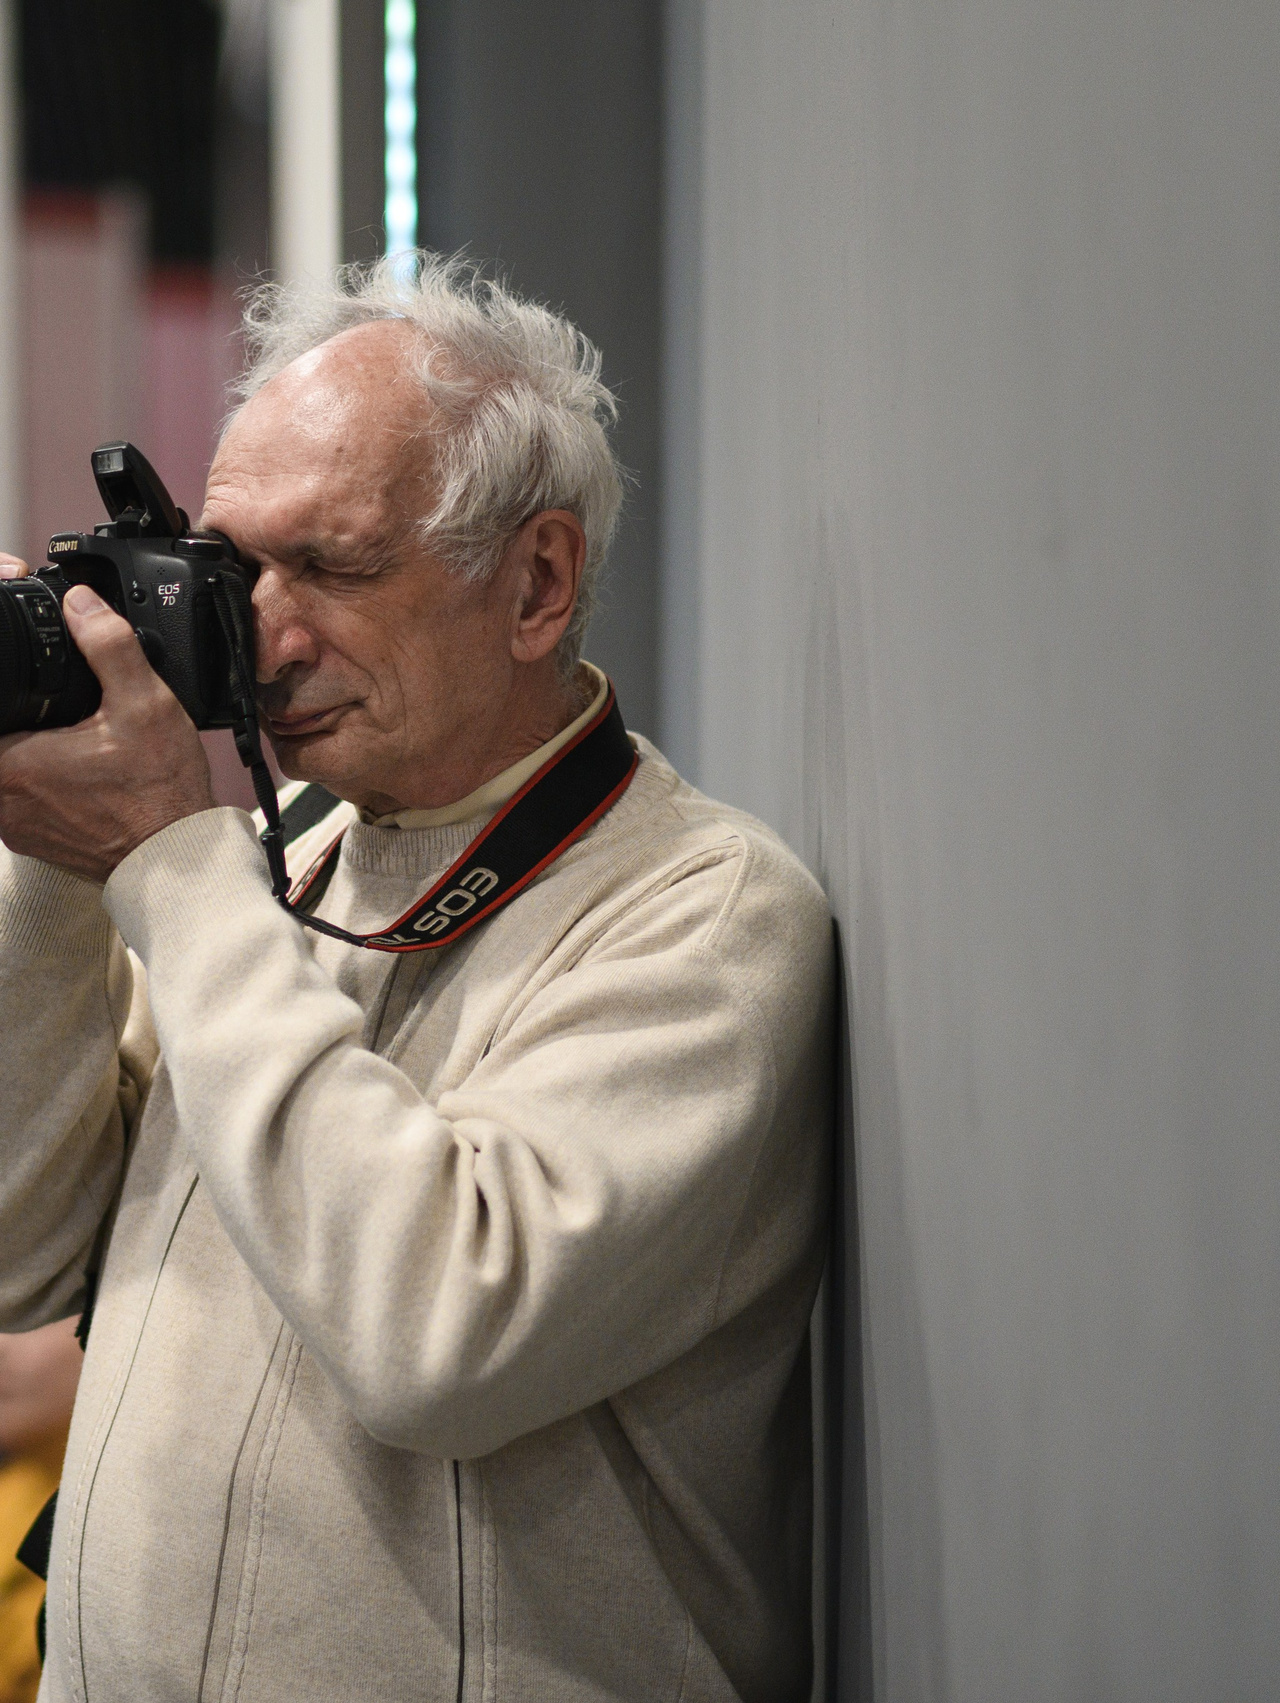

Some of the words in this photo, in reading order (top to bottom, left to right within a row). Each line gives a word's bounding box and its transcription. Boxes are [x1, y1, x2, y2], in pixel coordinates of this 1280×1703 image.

[49, 540, 78, 553] Canon
[158, 583, 180, 595] EOS
[162, 596, 176, 606] 7D
[413, 867, 499, 935] EOS
